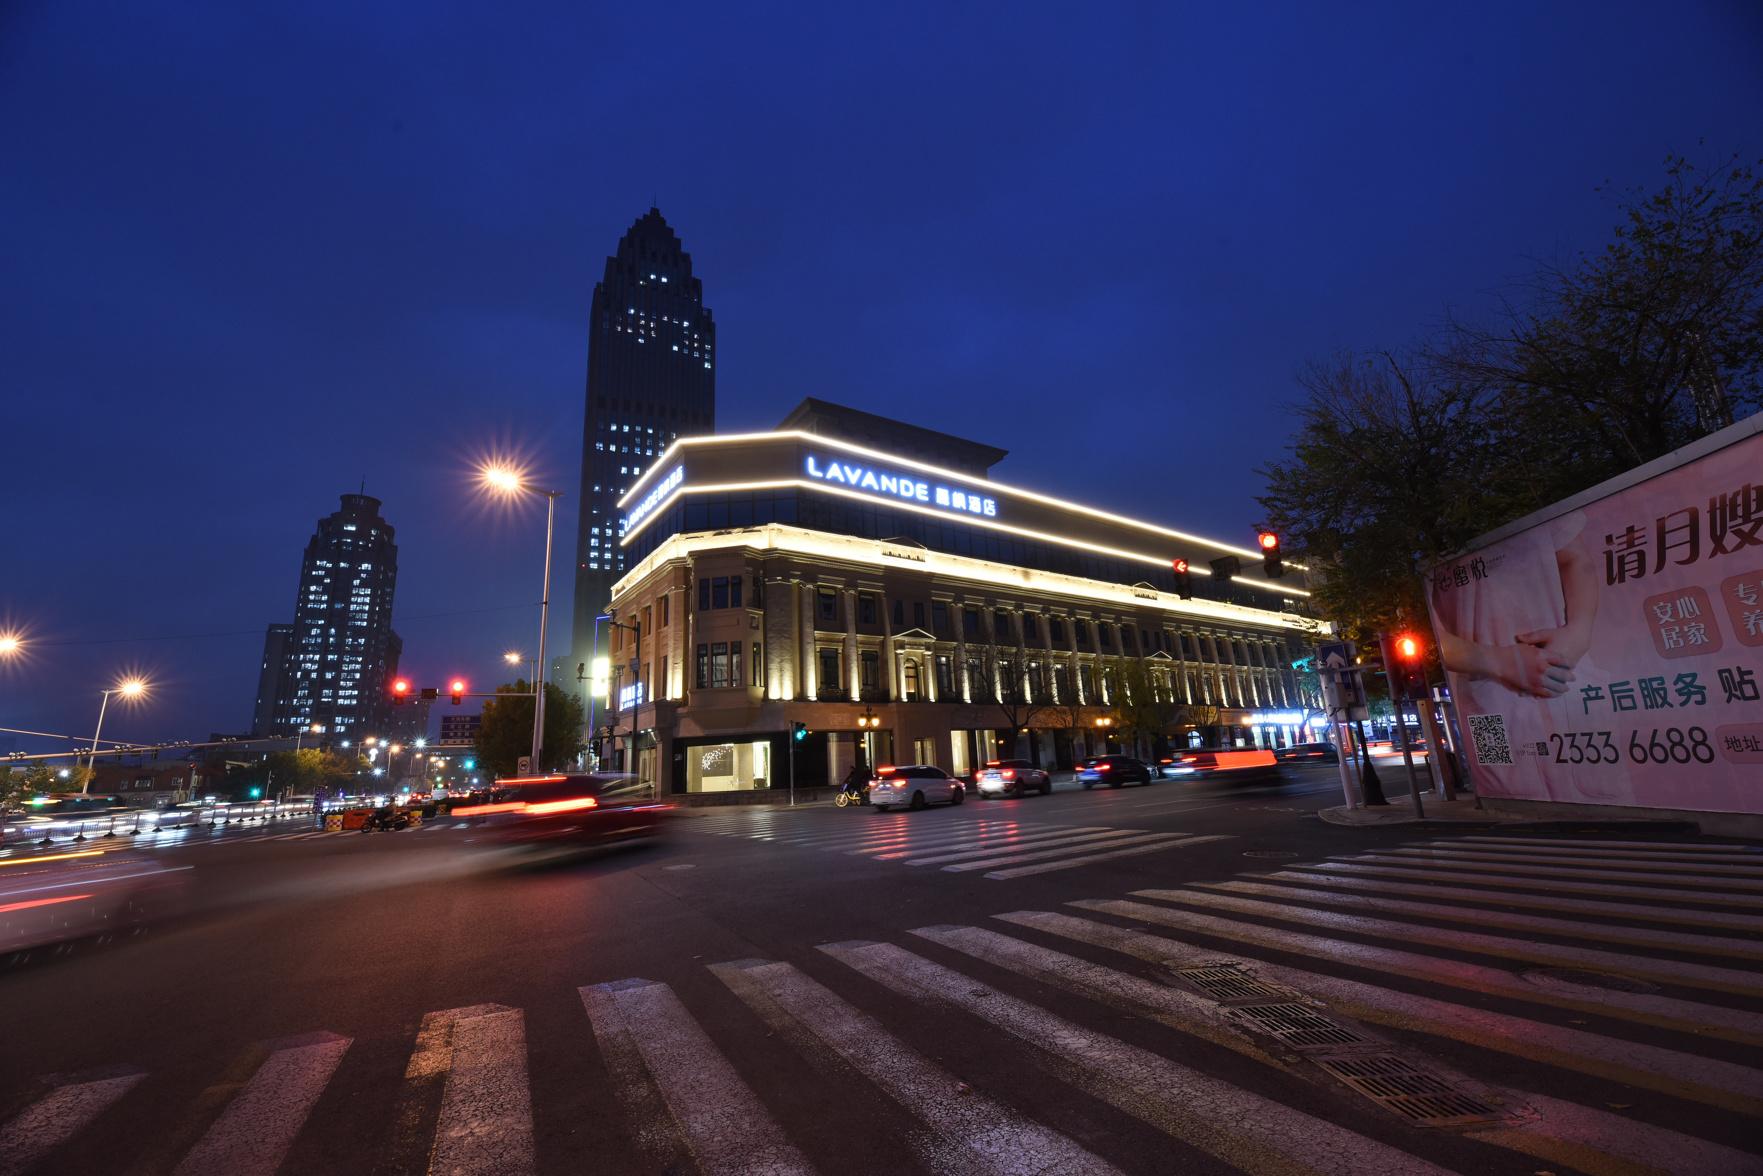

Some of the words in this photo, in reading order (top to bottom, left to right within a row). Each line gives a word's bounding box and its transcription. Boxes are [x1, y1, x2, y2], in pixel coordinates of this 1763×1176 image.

[807, 456, 929, 501] LAVANDE
[936, 487, 995, 516] 酒店
[625, 490, 658, 531] LNDE
[1602, 483, 1763, 586] 请月嫂
[1653, 596, 1701, 624] 安心
[1733, 580, 1763, 606] 专
[1661, 622, 1709, 650] 居家
[1580, 672, 1707, 715] 产后服务
[1718, 665, 1760, 704] 贴
[1550, 731, 1619, 764] 2333
[1629, 726, 1715, 764] 6688
[1724, 735, 1763, 752] 地址
